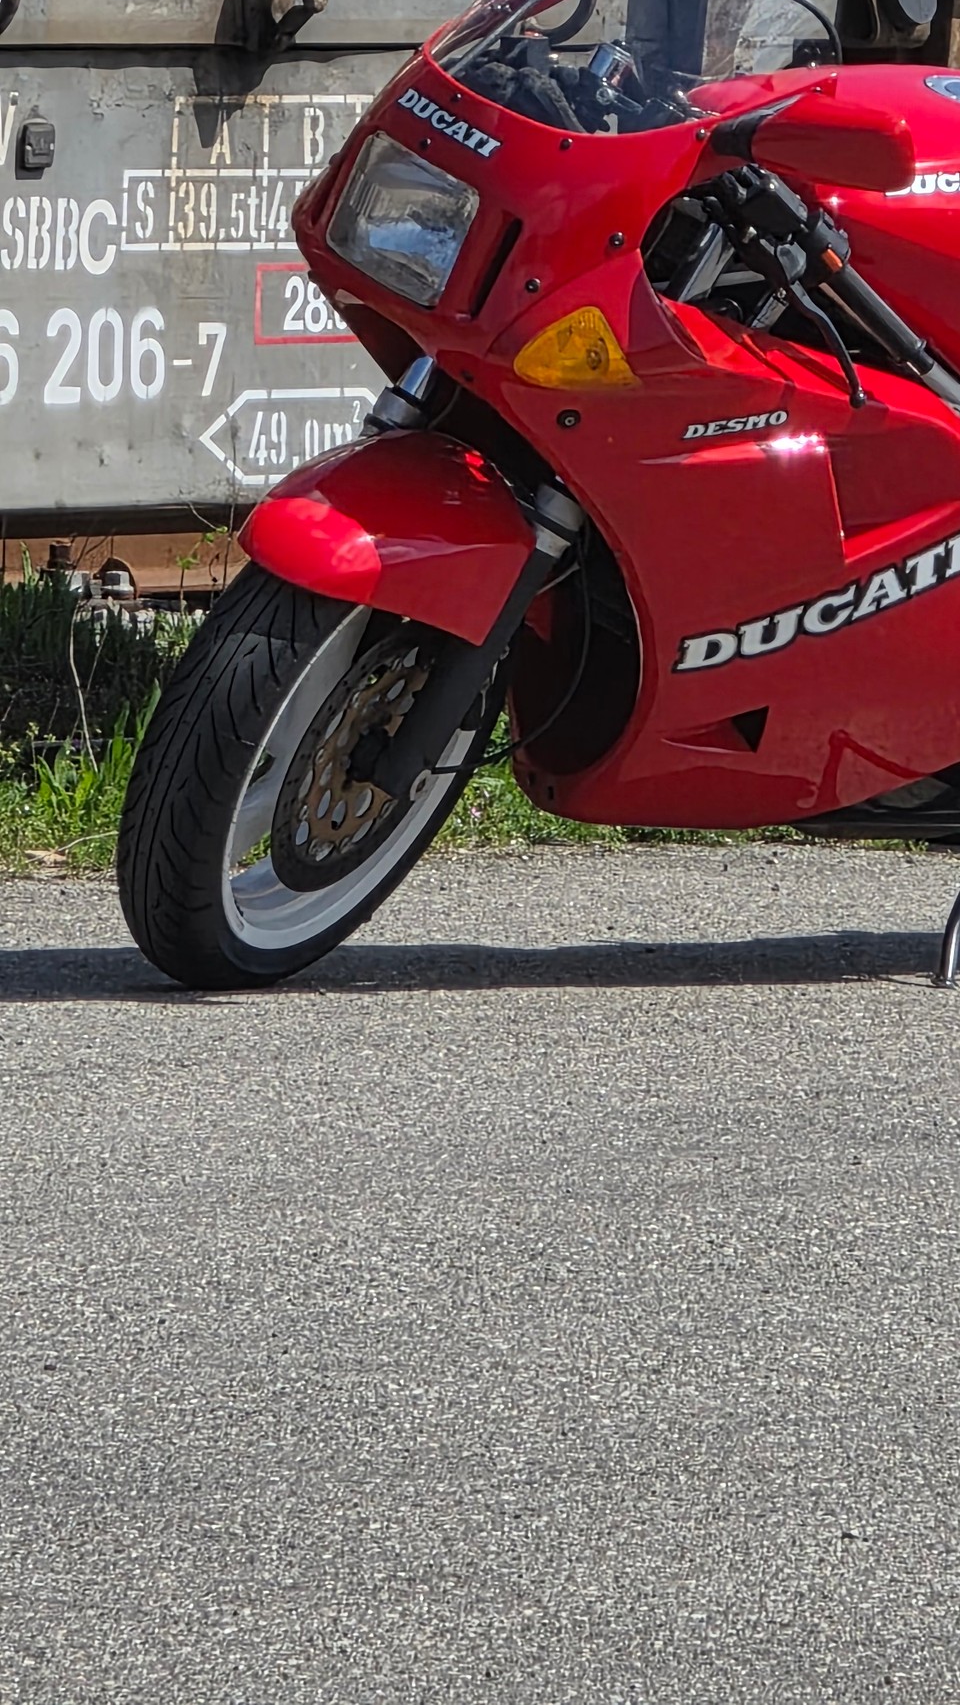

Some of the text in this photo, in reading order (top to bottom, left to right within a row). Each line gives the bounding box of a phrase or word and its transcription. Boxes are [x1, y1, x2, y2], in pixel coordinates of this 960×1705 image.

[303, 107, 325, 165] B
[396, 87, 502, 158] DUCATI
[135, 181, 155, 239] S
[683, 410, 788, 440] DESMO
